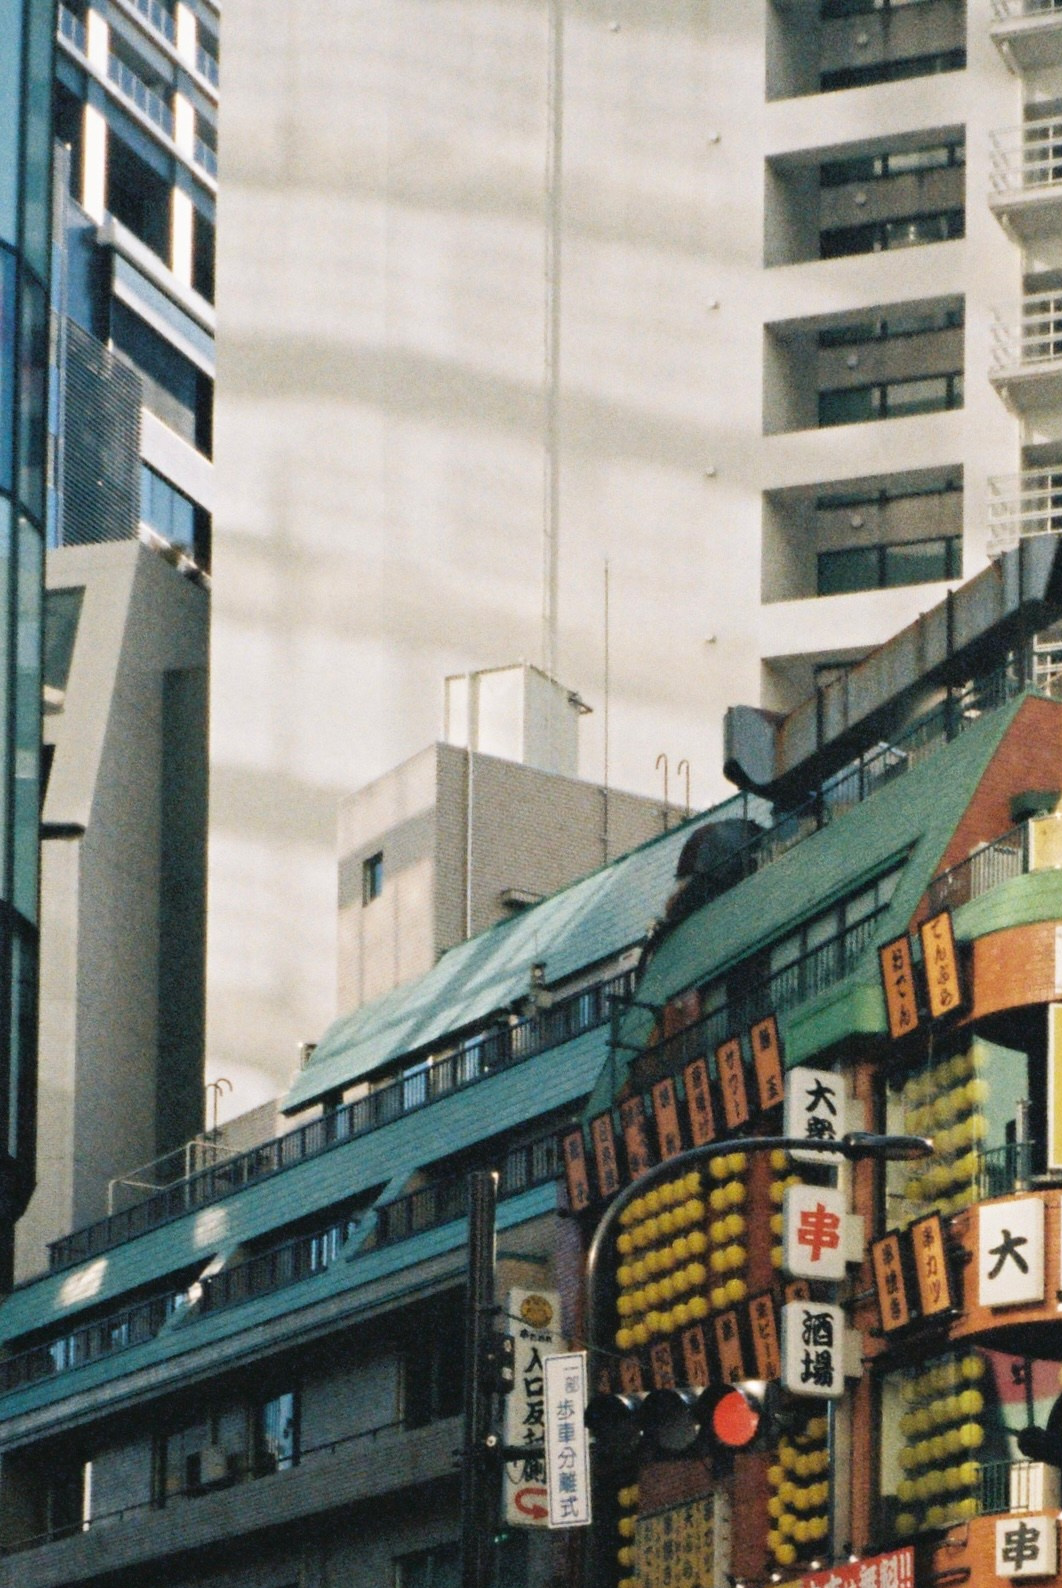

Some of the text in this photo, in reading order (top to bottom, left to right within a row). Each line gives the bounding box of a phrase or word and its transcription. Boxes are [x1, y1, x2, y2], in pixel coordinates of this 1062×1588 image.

[797, 1202, 840, 1262] 串
[923, 1226, 941, 1304] 串カツ
[801, 1312, 834, 1387] 酒場
